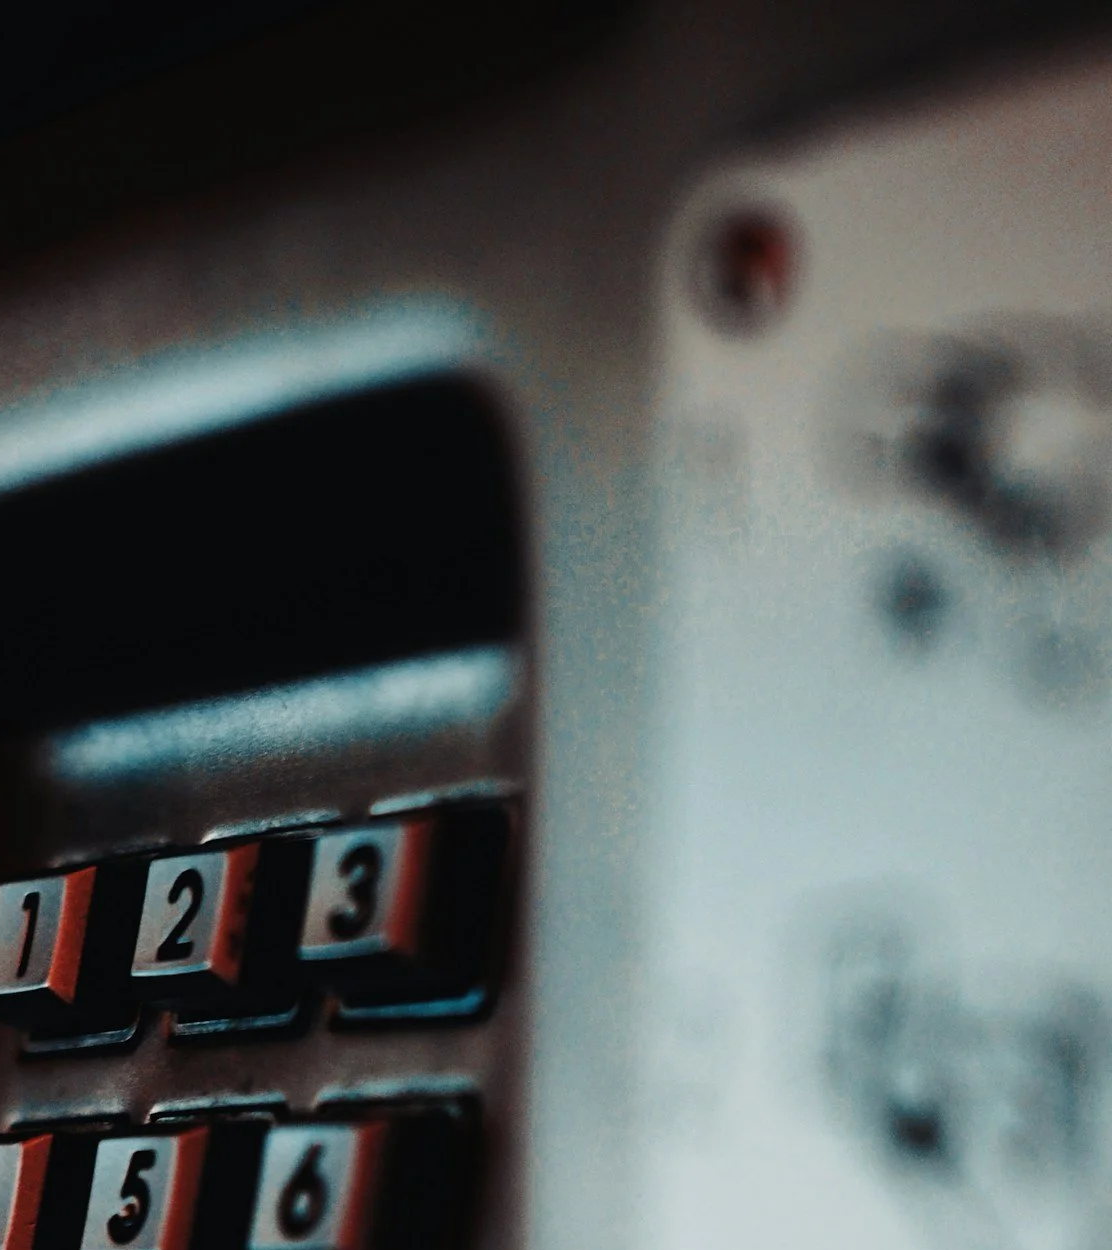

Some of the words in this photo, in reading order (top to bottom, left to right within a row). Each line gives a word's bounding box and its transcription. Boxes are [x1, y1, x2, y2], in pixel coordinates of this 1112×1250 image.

[16, 891, 41, 978] 1
[156, 868, 205, 962] 2
[328, 843, 382, 939] 3
[106, 1149, 157, 1245] 5
[276, 1143, 330, 1241] 6
